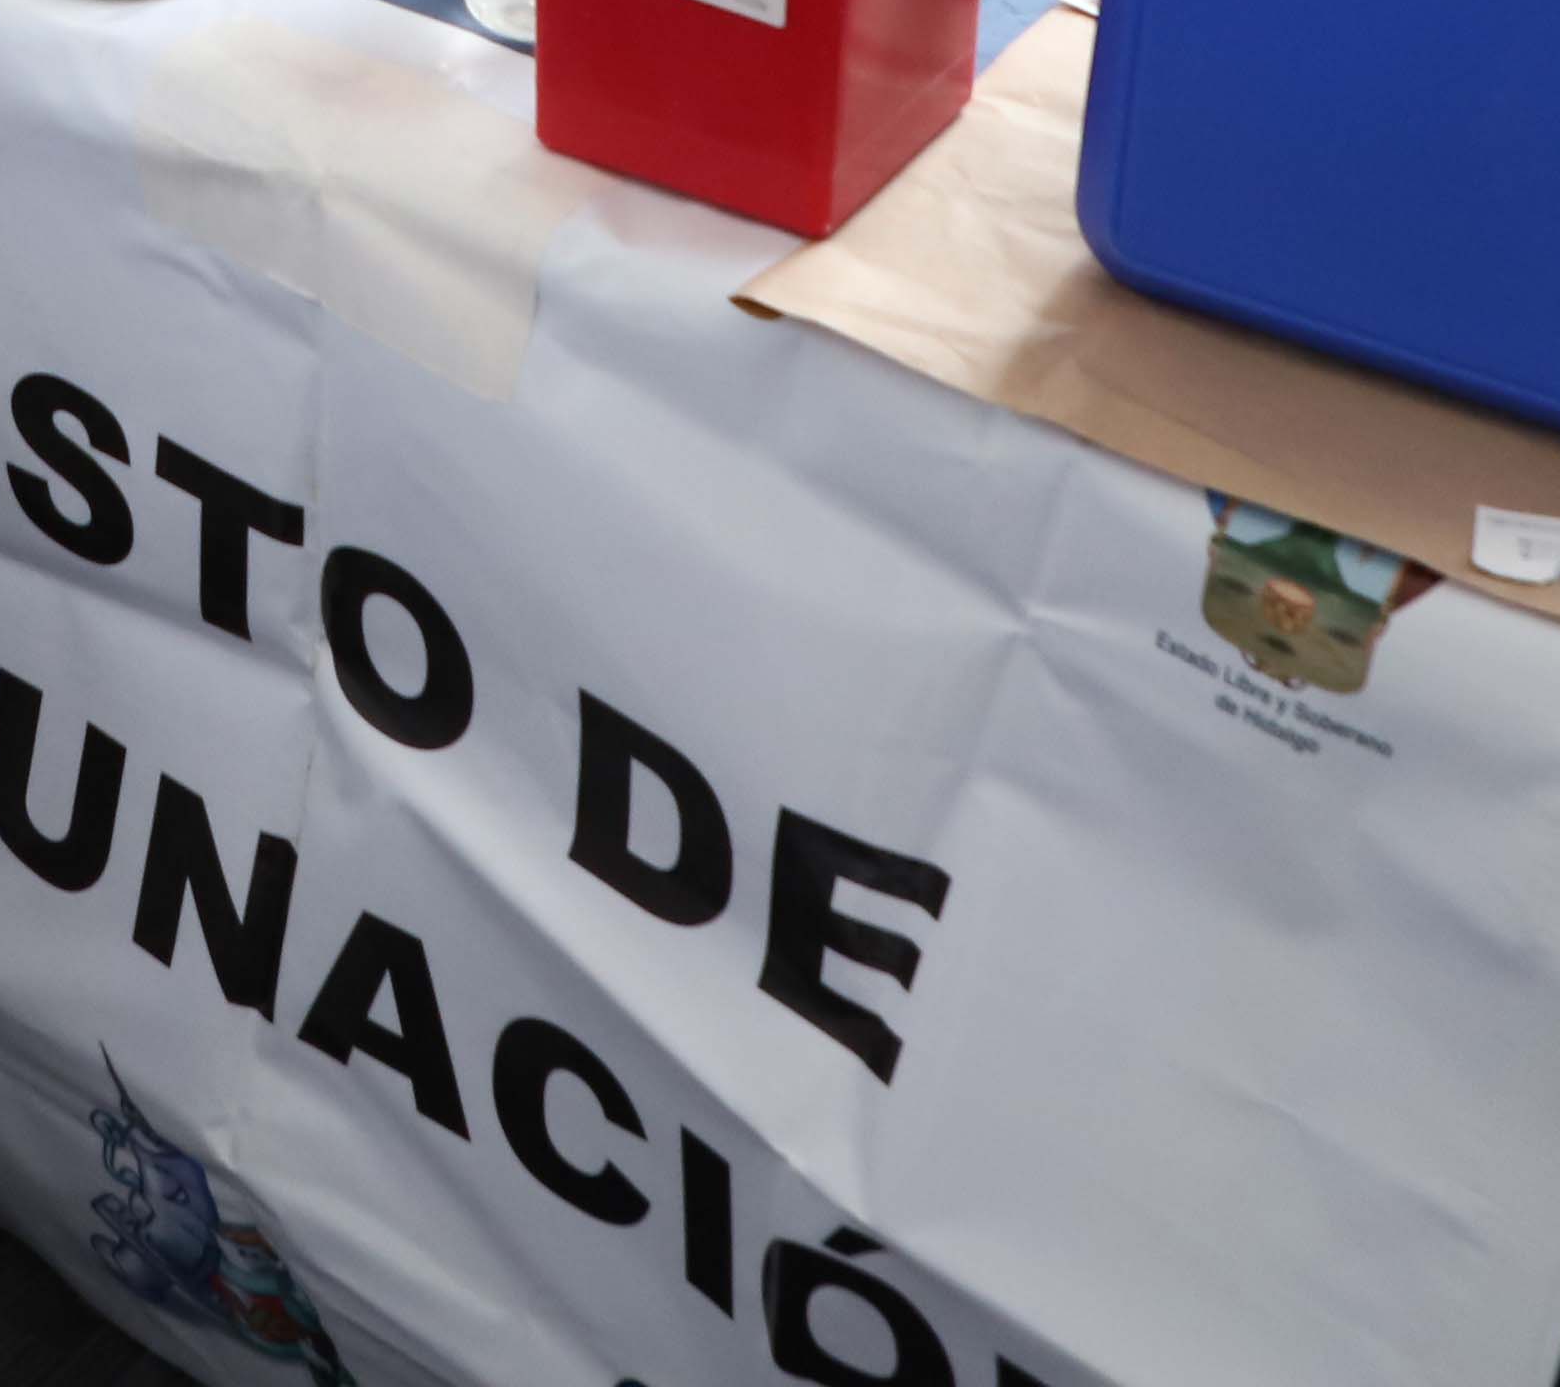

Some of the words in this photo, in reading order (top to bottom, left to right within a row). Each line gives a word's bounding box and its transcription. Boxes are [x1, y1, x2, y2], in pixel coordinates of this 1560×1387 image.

[1156, 629, 1219, 679] Estado
[1223, 666, 1272, 705] Libre
[1294, 700, 1394, 759] Soberano
[568, 686, 953, 1088] DE
